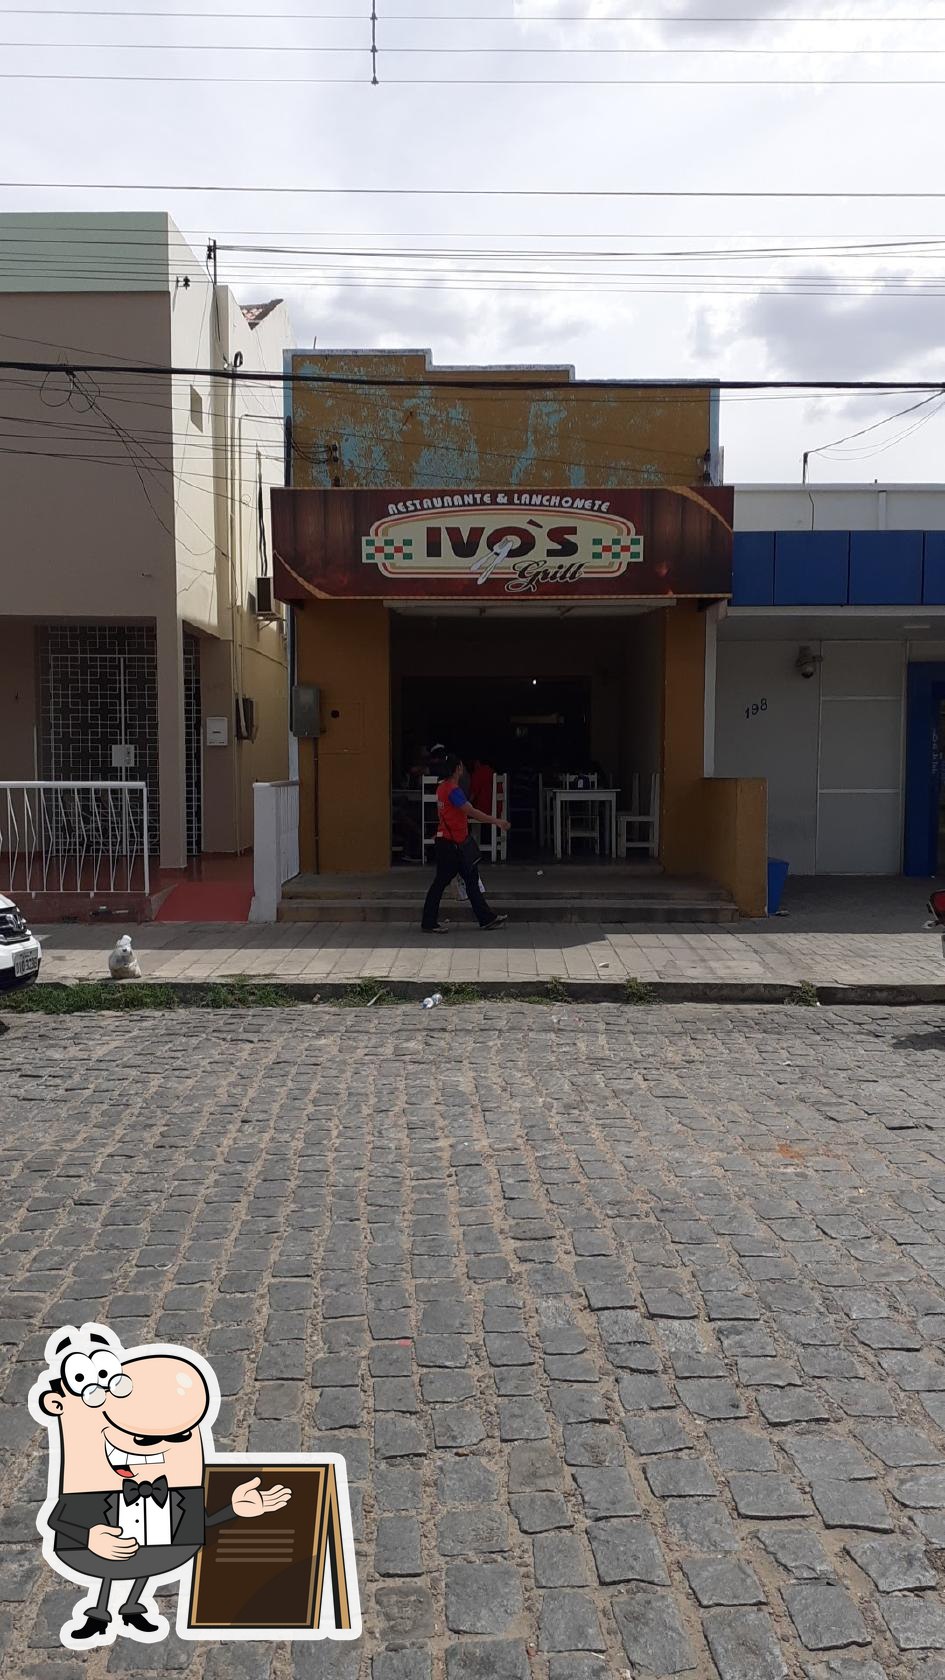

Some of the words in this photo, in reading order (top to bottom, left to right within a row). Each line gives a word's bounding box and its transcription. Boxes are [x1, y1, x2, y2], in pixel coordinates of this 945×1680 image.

[387, 493, 491, 514] RESTAURANTE
[496, 493, 508, 504] &
[513, 493, 610, 512] LANCHONETE
[505, 559, 588, 592] Grill
[745, 697, 768, 719] 198
